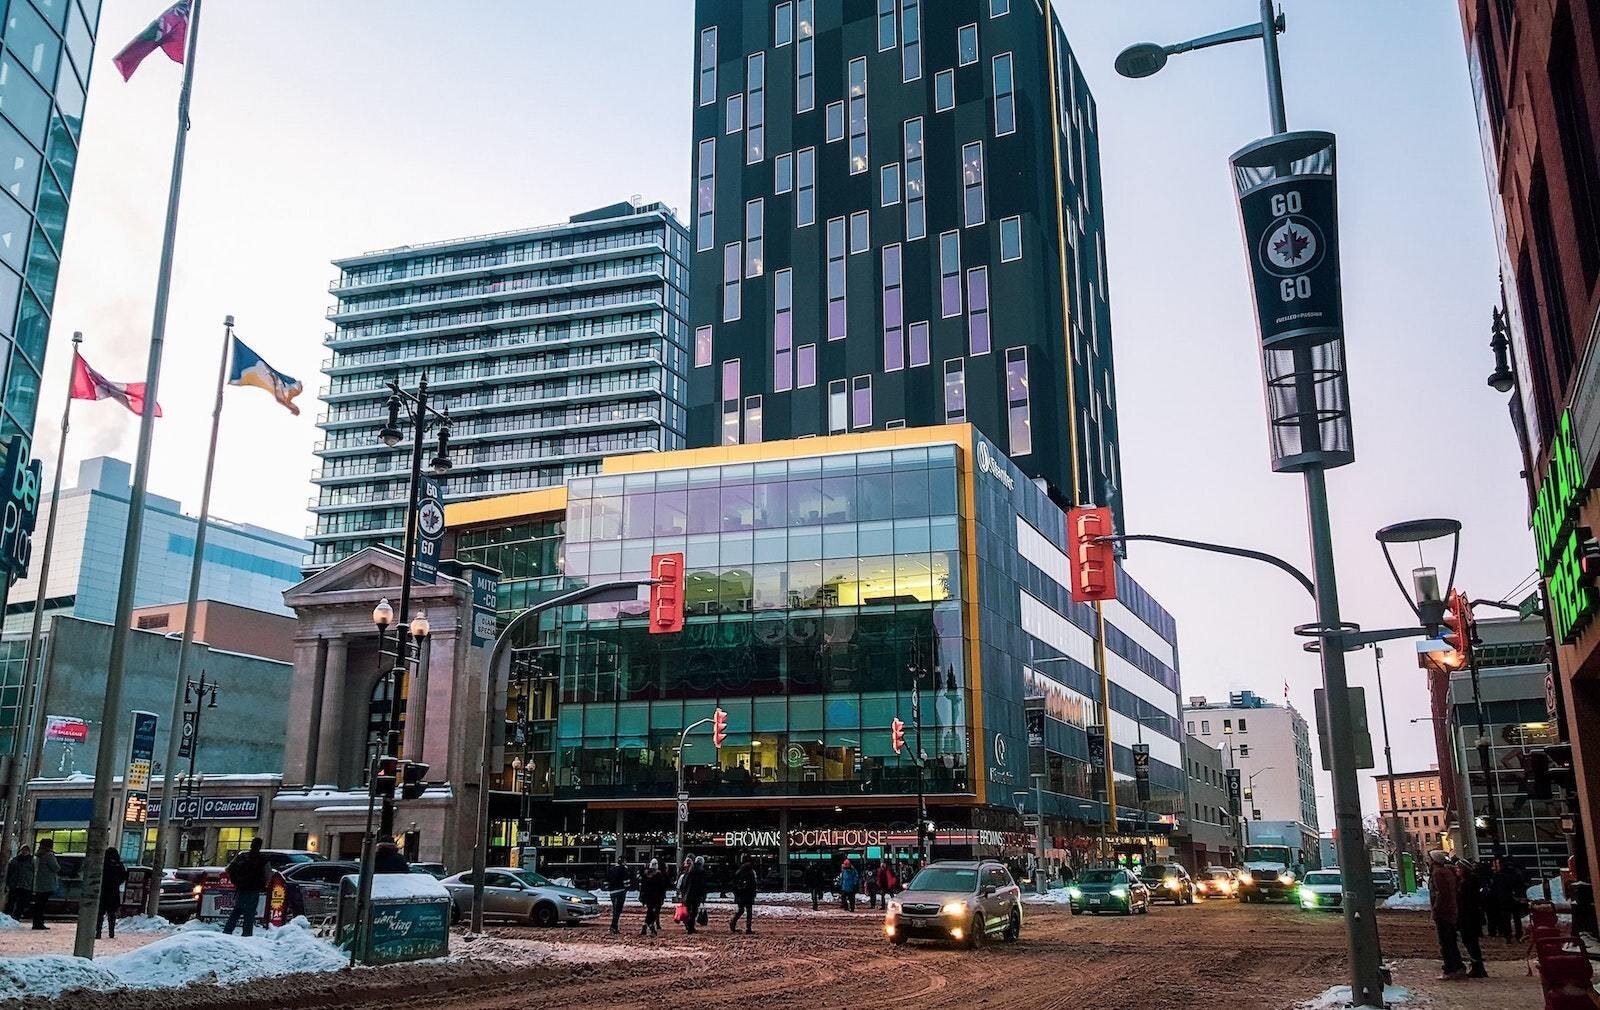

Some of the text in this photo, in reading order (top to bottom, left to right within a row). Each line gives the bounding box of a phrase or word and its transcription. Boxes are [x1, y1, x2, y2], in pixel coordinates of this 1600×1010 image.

[1271, 190, 1302, 217] GO
[1280, 275, 1311, 302] GO
[426, 482, 438, 499] GO
[1533, 408, 1583, 580] DOLLAR
[421, 539, 434, 556] GO
[1550, 529, 1588, 645] TREE
[214, 800, 256, 812] Calcutta
